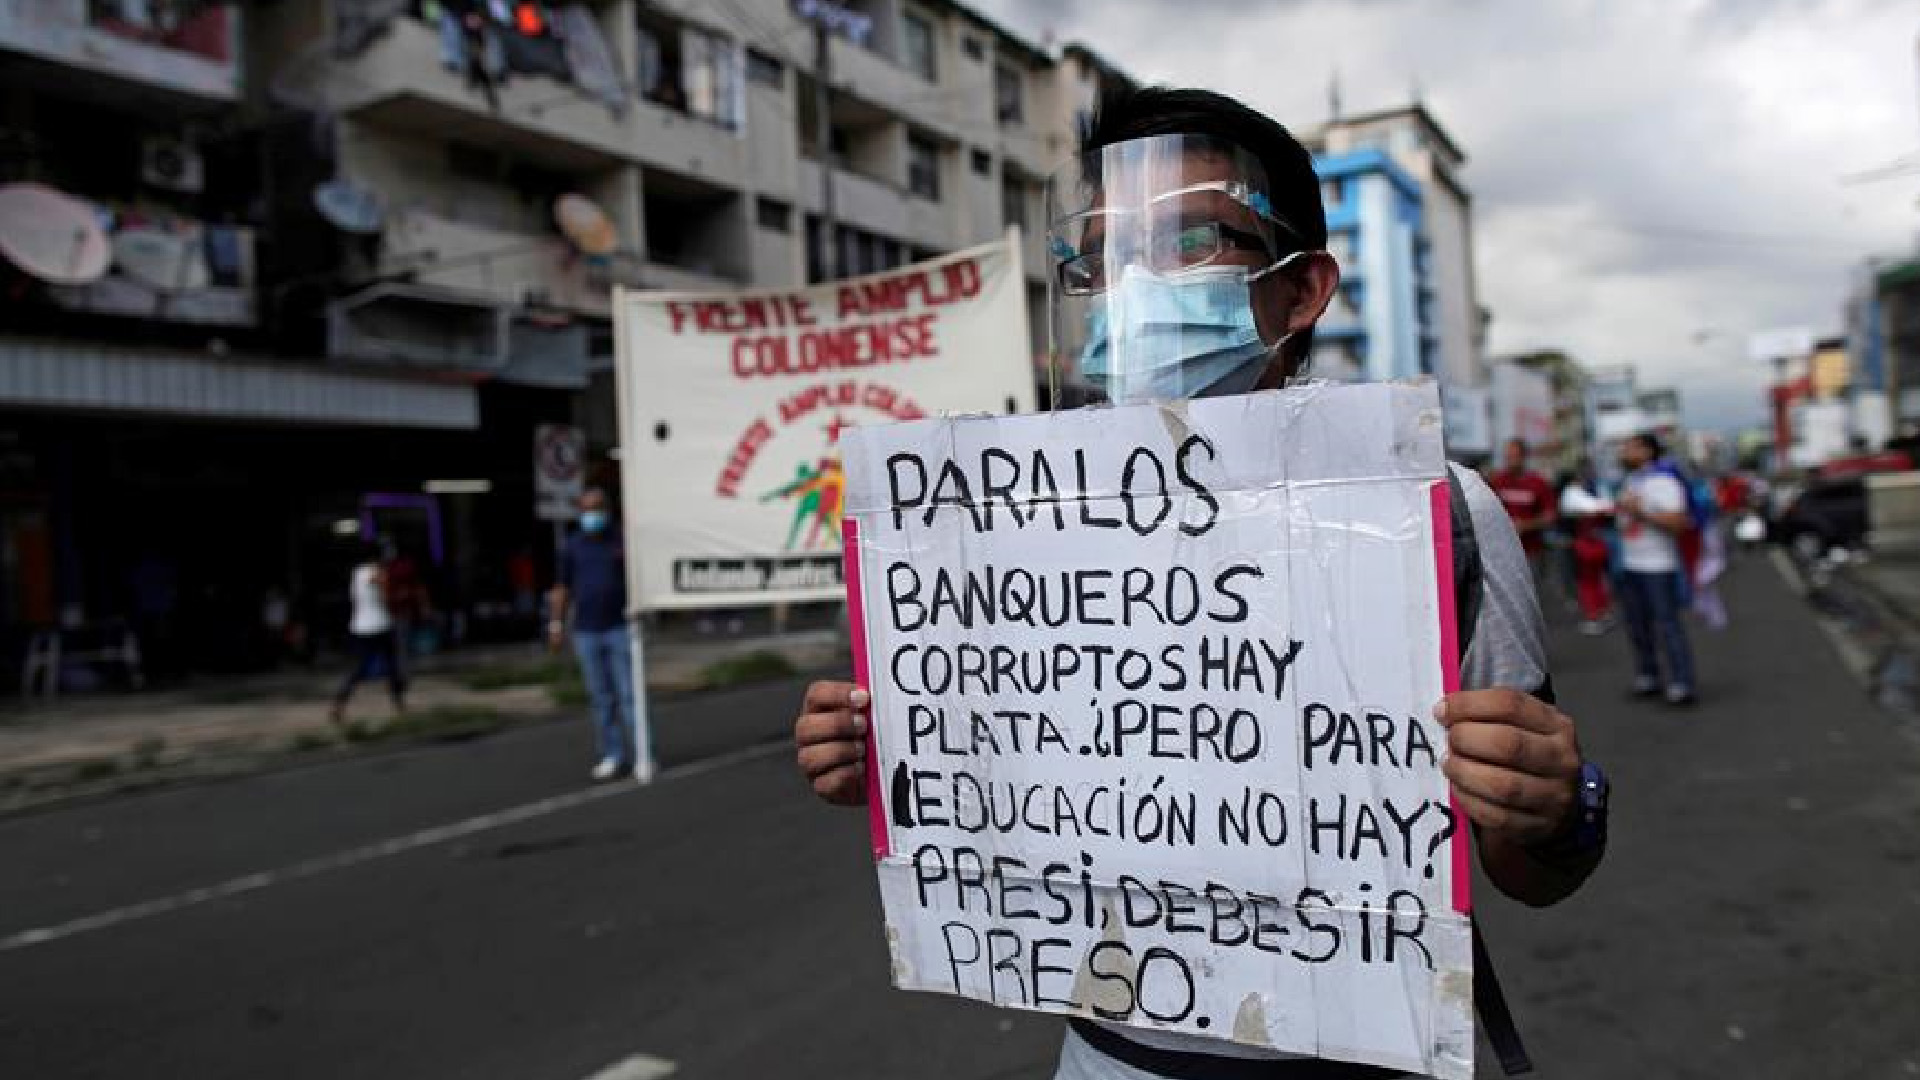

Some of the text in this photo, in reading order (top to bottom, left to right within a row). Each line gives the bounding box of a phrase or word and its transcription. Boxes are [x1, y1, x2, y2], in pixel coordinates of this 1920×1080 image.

[667, 259, 981, 336] FRENTE AMPLIO
[731, 312, 940, 378] COLONENSE
[886, 561, 1266, 633] BANQUEROS
[891, 636, 1305, 701] CORRUPTOS HAY
[1302, 703, 1438, 770] PARA
[1218, 786, 1288, 847] NO
[1310, 793, 1456, 880] HAY?
[1118, 873, 1343, 964] DEBES
[941, 920, 1212, 1030] PRESO.
